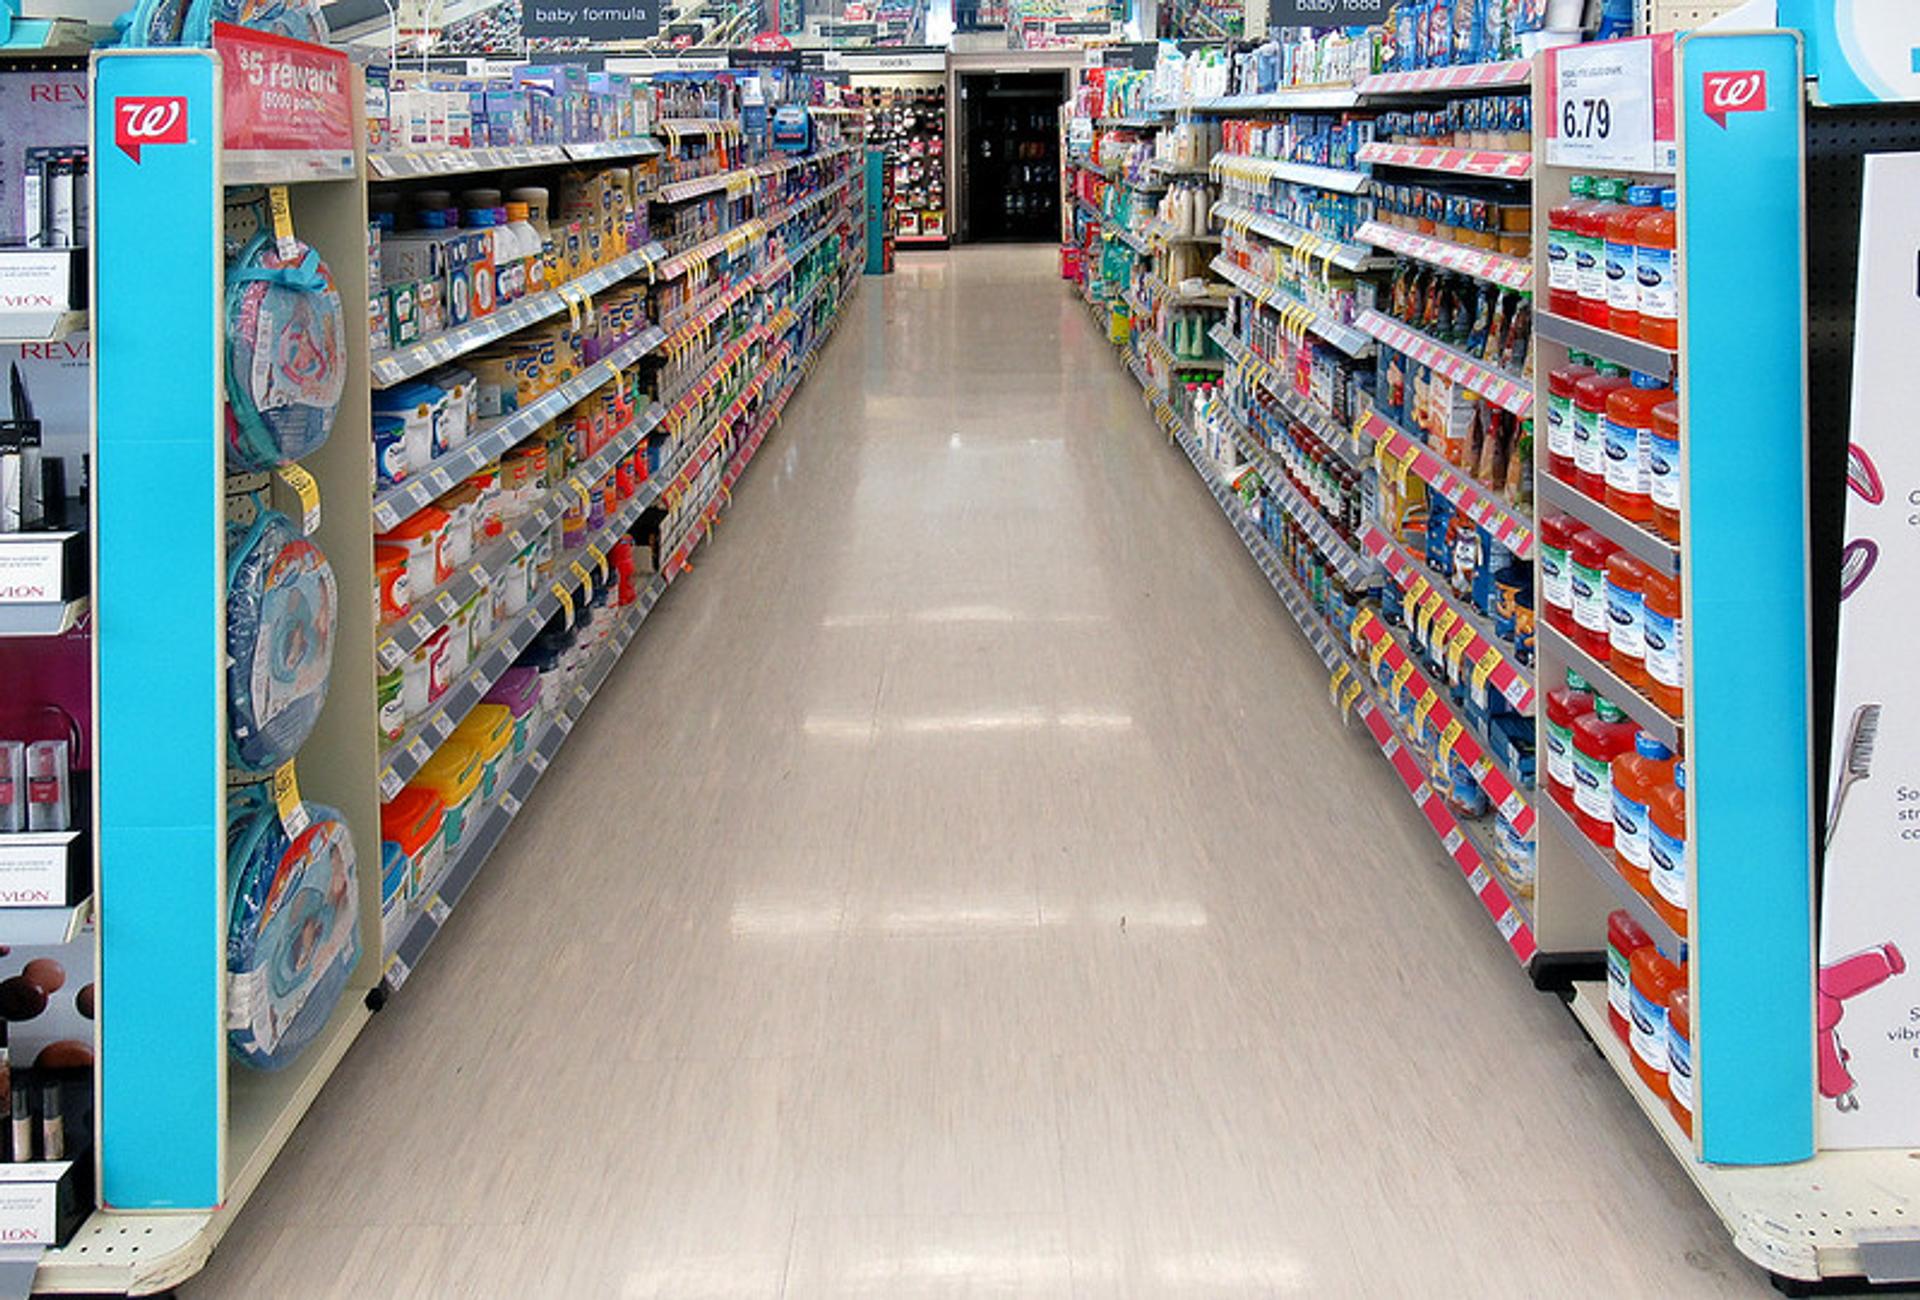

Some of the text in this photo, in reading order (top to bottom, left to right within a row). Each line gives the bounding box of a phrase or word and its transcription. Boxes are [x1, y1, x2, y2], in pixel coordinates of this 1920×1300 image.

[535, 7, 646, 24] baby formula
[1296, 0, 1380, 13] baby food
[270, 61, 339, 95] reward
[1563, 98, 1611, 138] 6.79
